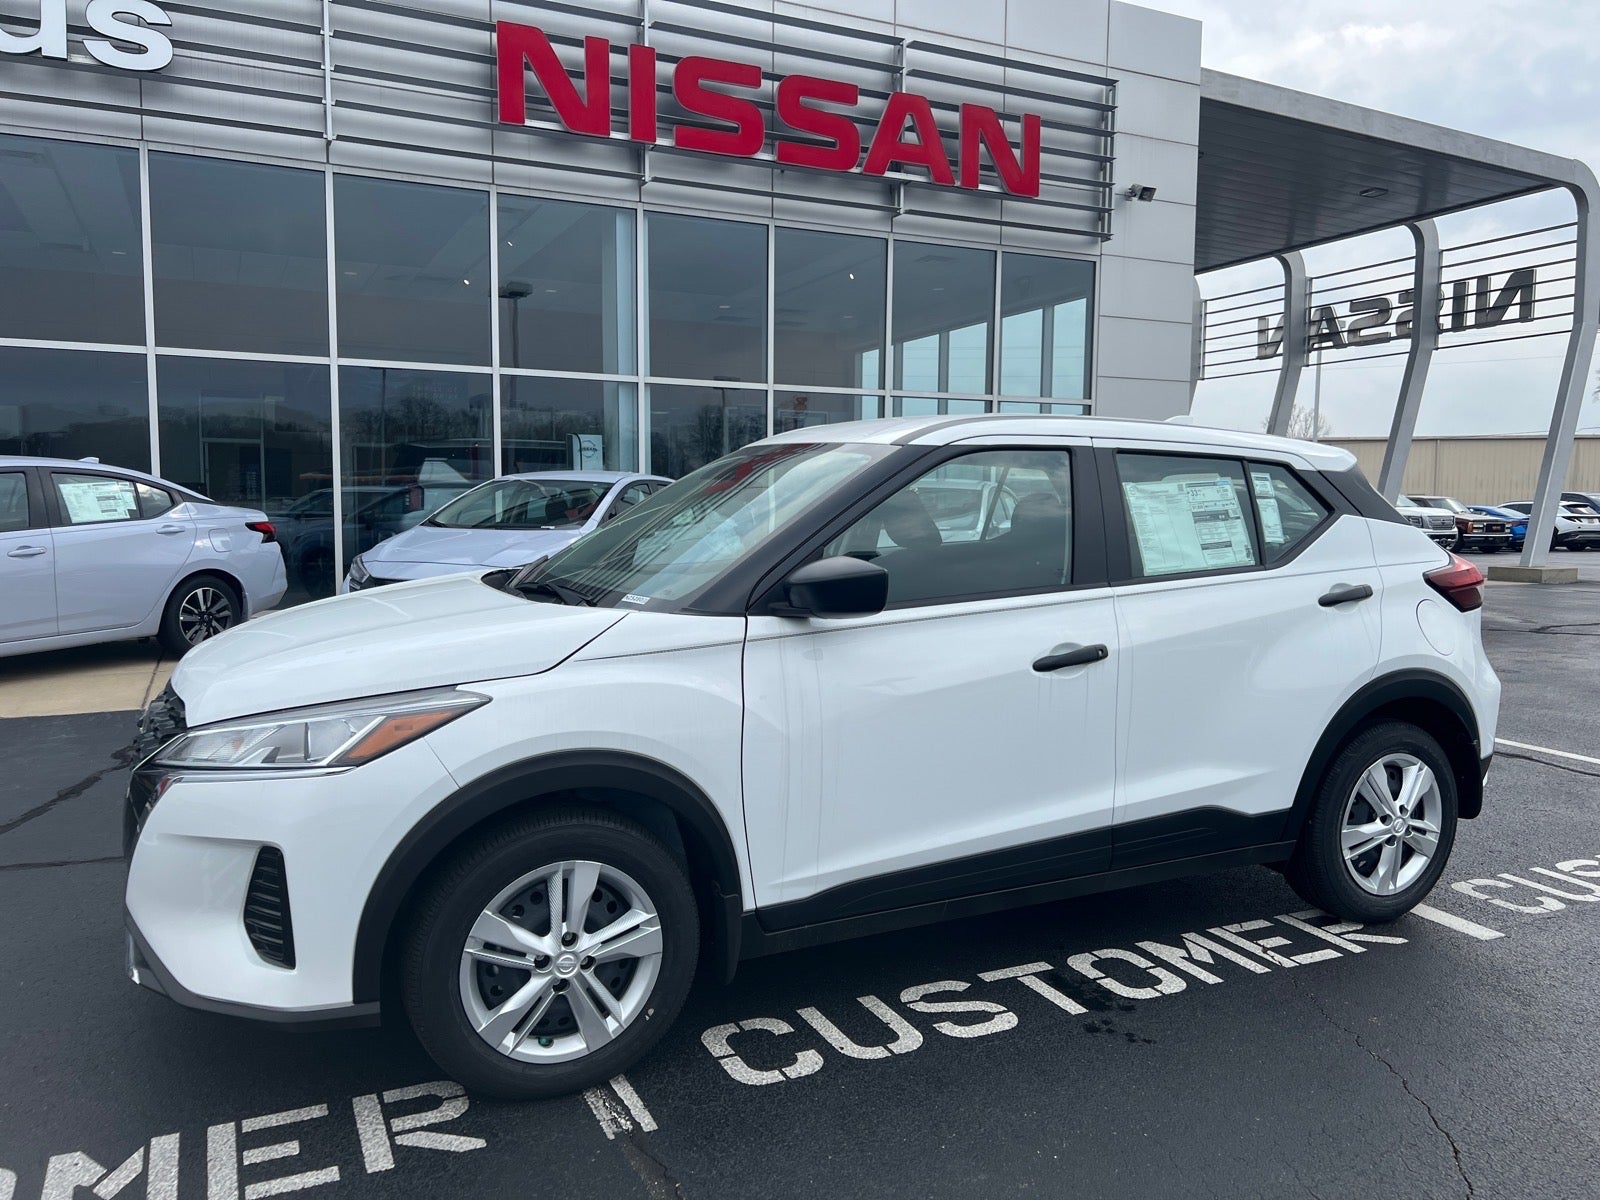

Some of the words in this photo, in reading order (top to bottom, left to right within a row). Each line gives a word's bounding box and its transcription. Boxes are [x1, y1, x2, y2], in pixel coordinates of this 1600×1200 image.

[496, 20, 1040, 198] NISSAN
[701, 908, 1409, 1086] CUSTOMER
[0, 1080, 487, 1200] MER
